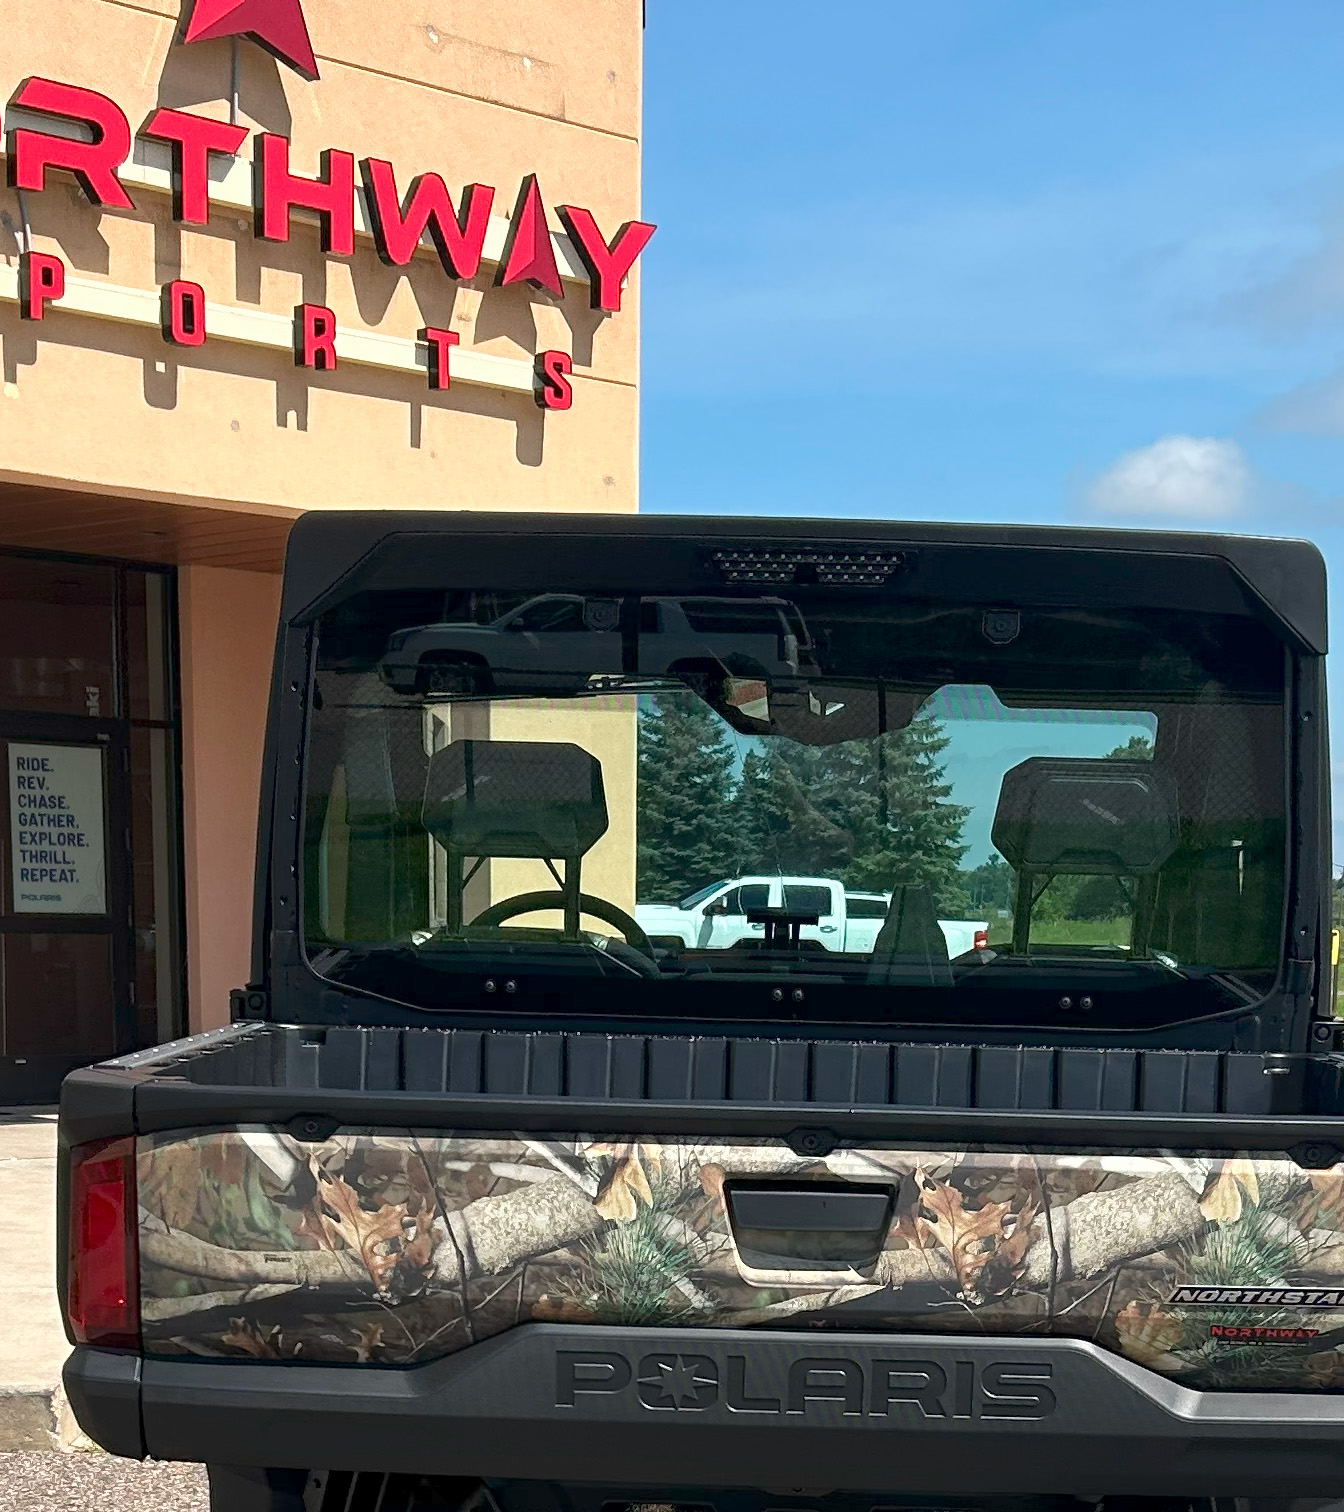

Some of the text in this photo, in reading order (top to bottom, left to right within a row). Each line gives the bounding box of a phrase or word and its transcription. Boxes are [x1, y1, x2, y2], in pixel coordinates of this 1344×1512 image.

[16, 756, 54, 772] RIDE.
[17, 775, 50, 791] REV.
[17, 793, 70, 810] CHASE.
[19, 831, 90, 848] EXPLORE.
[20, 849, 76, 865] THRILL.
[20, 868, 80, 884] REPEAT.
[554, 1350, 1057, 1421] POLARIS
